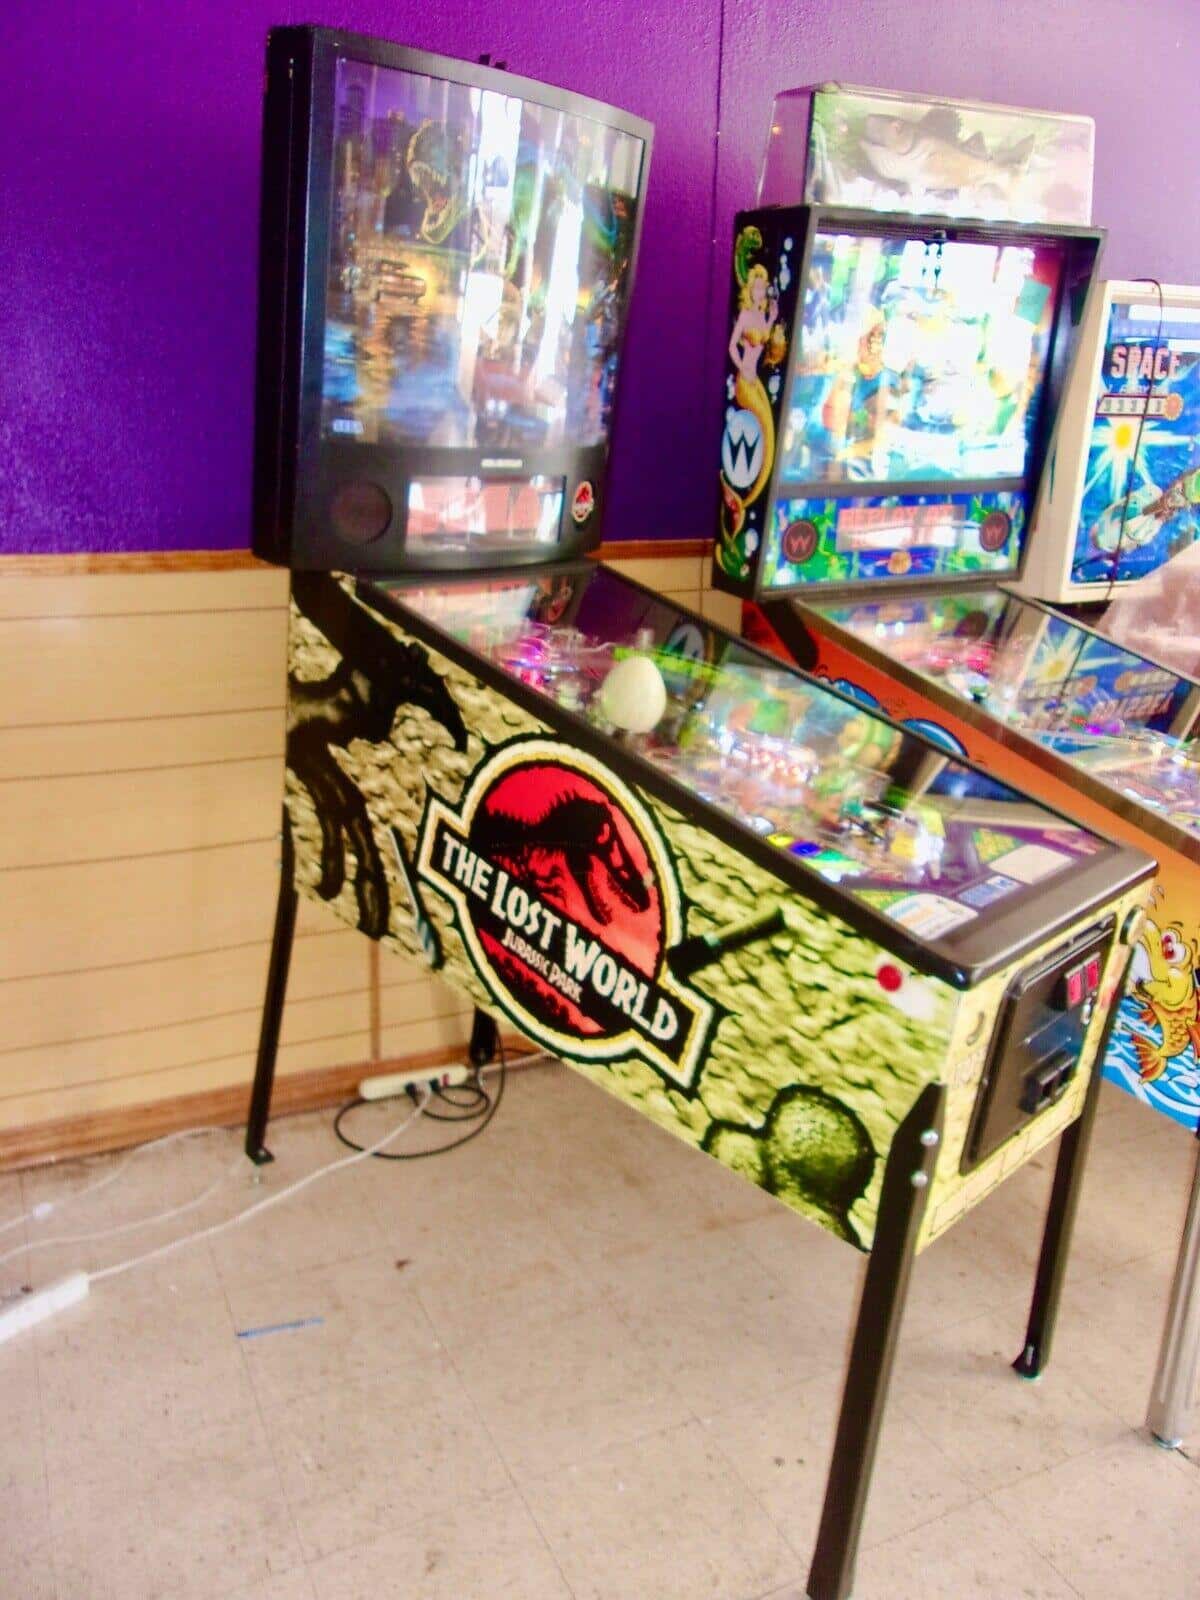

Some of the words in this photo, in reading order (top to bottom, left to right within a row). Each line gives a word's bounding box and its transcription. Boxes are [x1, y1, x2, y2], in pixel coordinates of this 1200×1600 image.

[1110, 345, 1181, 379] SPACE
[443, 832, 494, 900] THE
[489, 872, 561, 950] LOST
[564, 923, 678, 1040] WORLD
[501, 927, 550, 976] JURASSIC
[548, 963, 582, 1003] PARK
